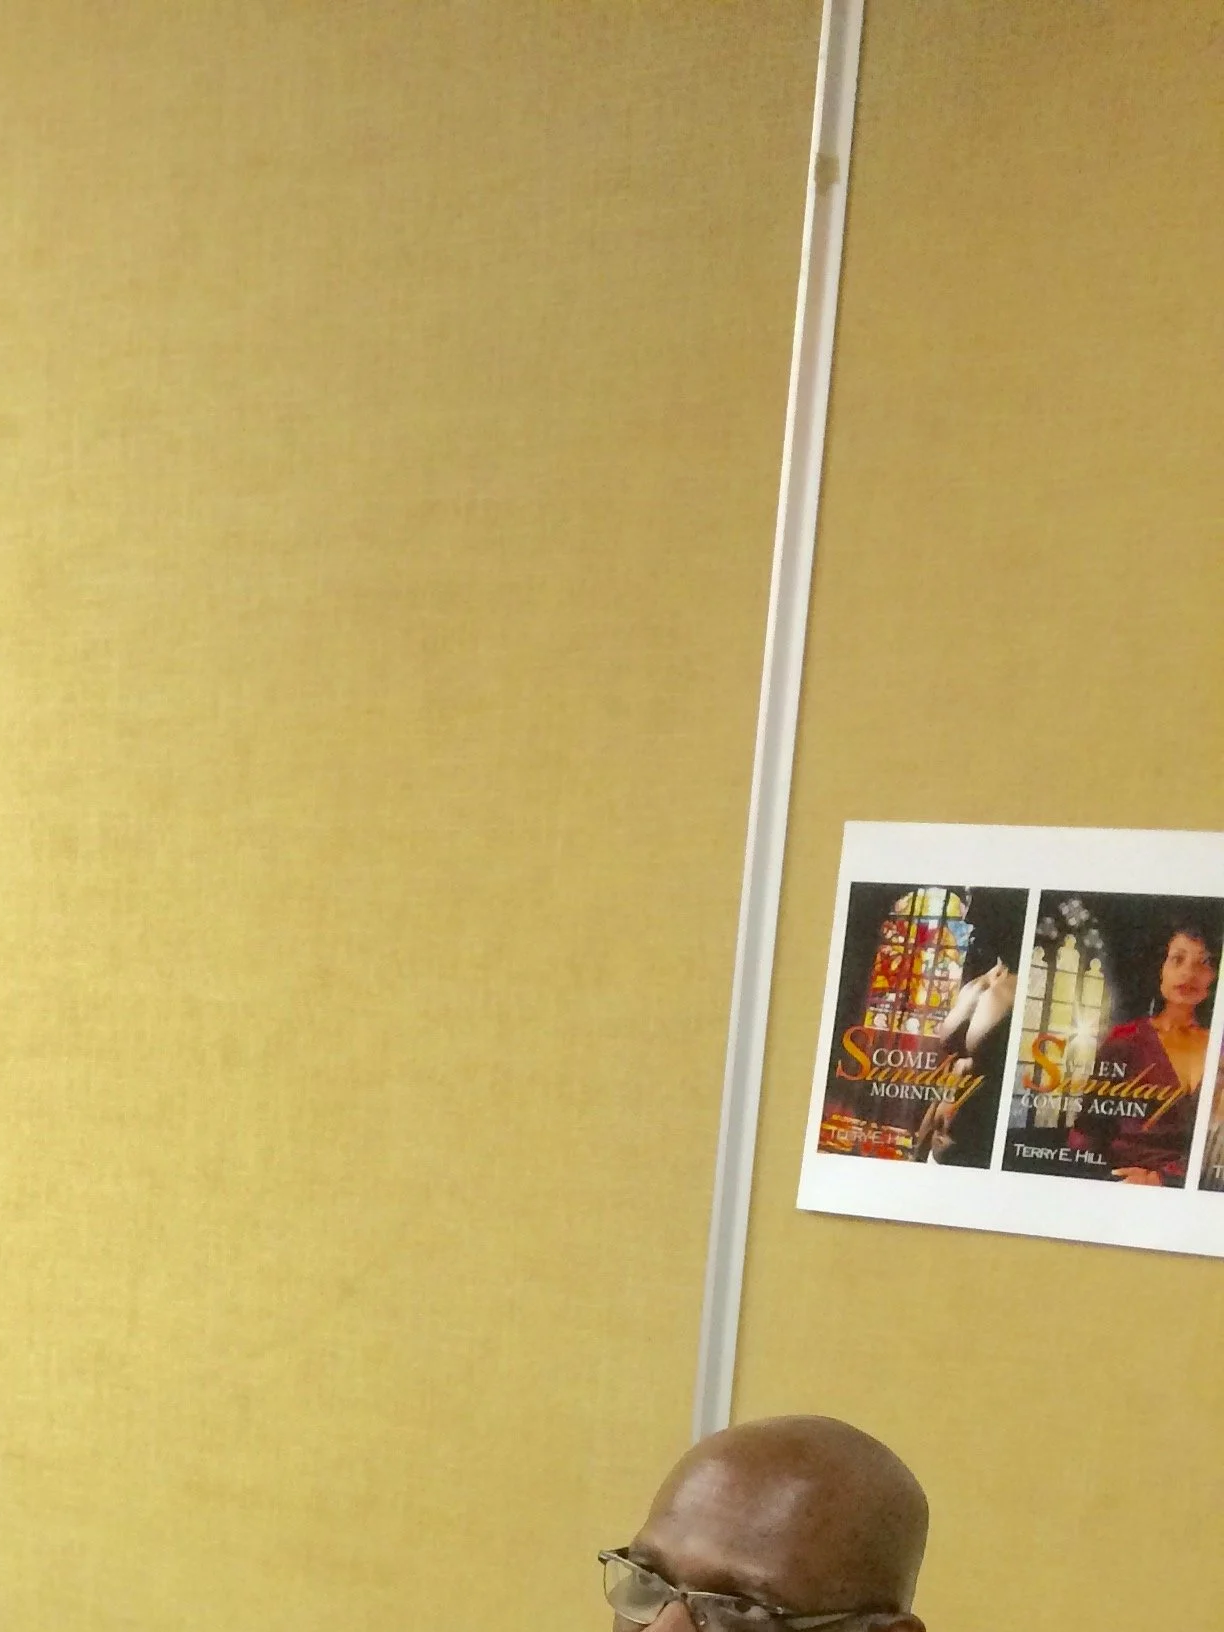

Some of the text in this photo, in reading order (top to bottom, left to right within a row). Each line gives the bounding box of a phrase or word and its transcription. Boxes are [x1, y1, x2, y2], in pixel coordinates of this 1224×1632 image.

[872, 1047, 938, 1071] COME
[836, 1025, 985, 1118] Sunday
[1021, 1033, 1184, 1132] Sunday
[870, 1082, 957, 1104] MORNING
[1088, 1098, 1148, 1118] AGAIN
[1013, 1143, 1058, 1160] TERRY
[1076, 1150, 1108, 1166] HILL
